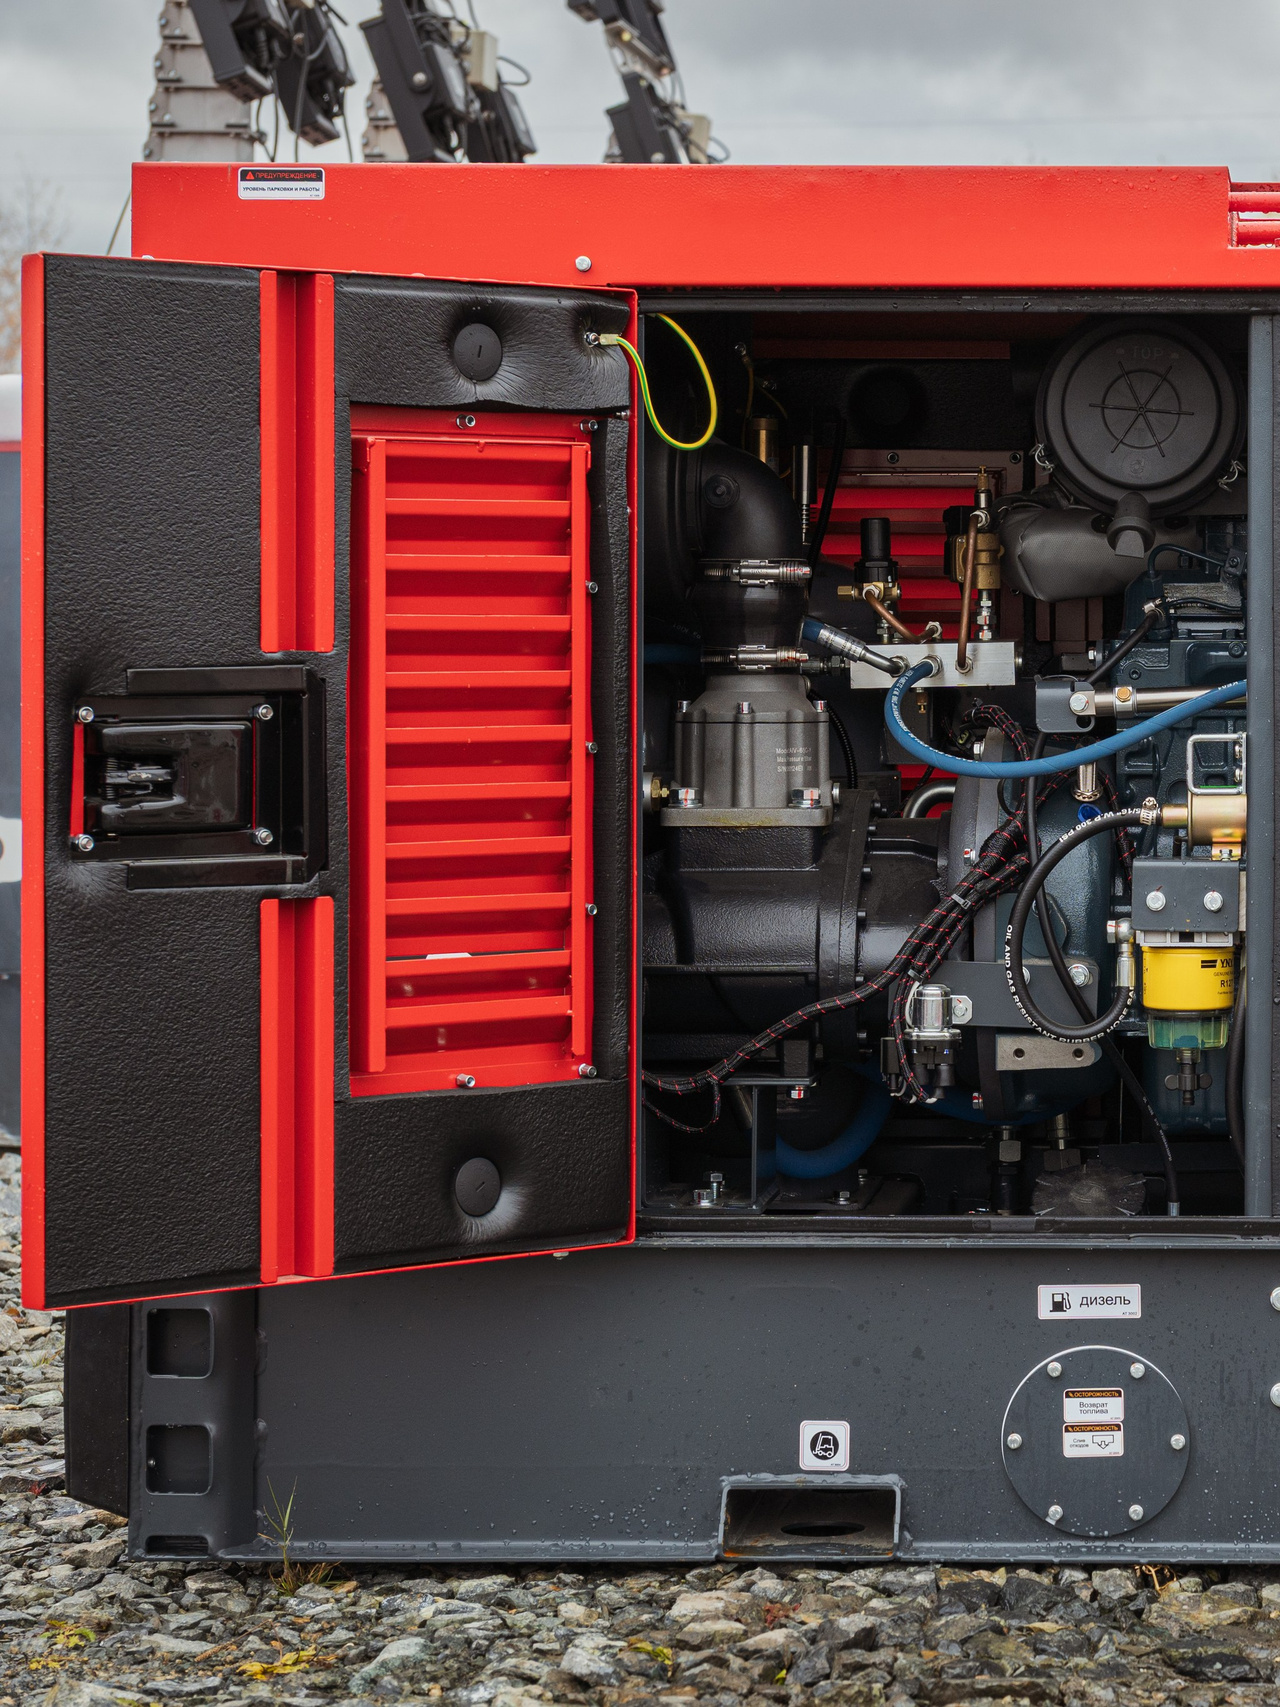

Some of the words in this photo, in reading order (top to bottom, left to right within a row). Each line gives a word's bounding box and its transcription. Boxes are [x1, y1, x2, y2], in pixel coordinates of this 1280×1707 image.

[1131, 346, 1164, 360] TOP
[1075, 819, 1093, 831] 300
[1059, 827, 1074, 843] PSI
[1005, 924, 1013, 942] OIL
[1004, 945, 1012, 968] AND
[1006, 970, 1016, 994] GAS
[1012, 994, 1058, 1040] RESISTANT
[1079, 1295, 1131, 1308] дизель
[1079, 1401, 1108, 1409] Возврат
